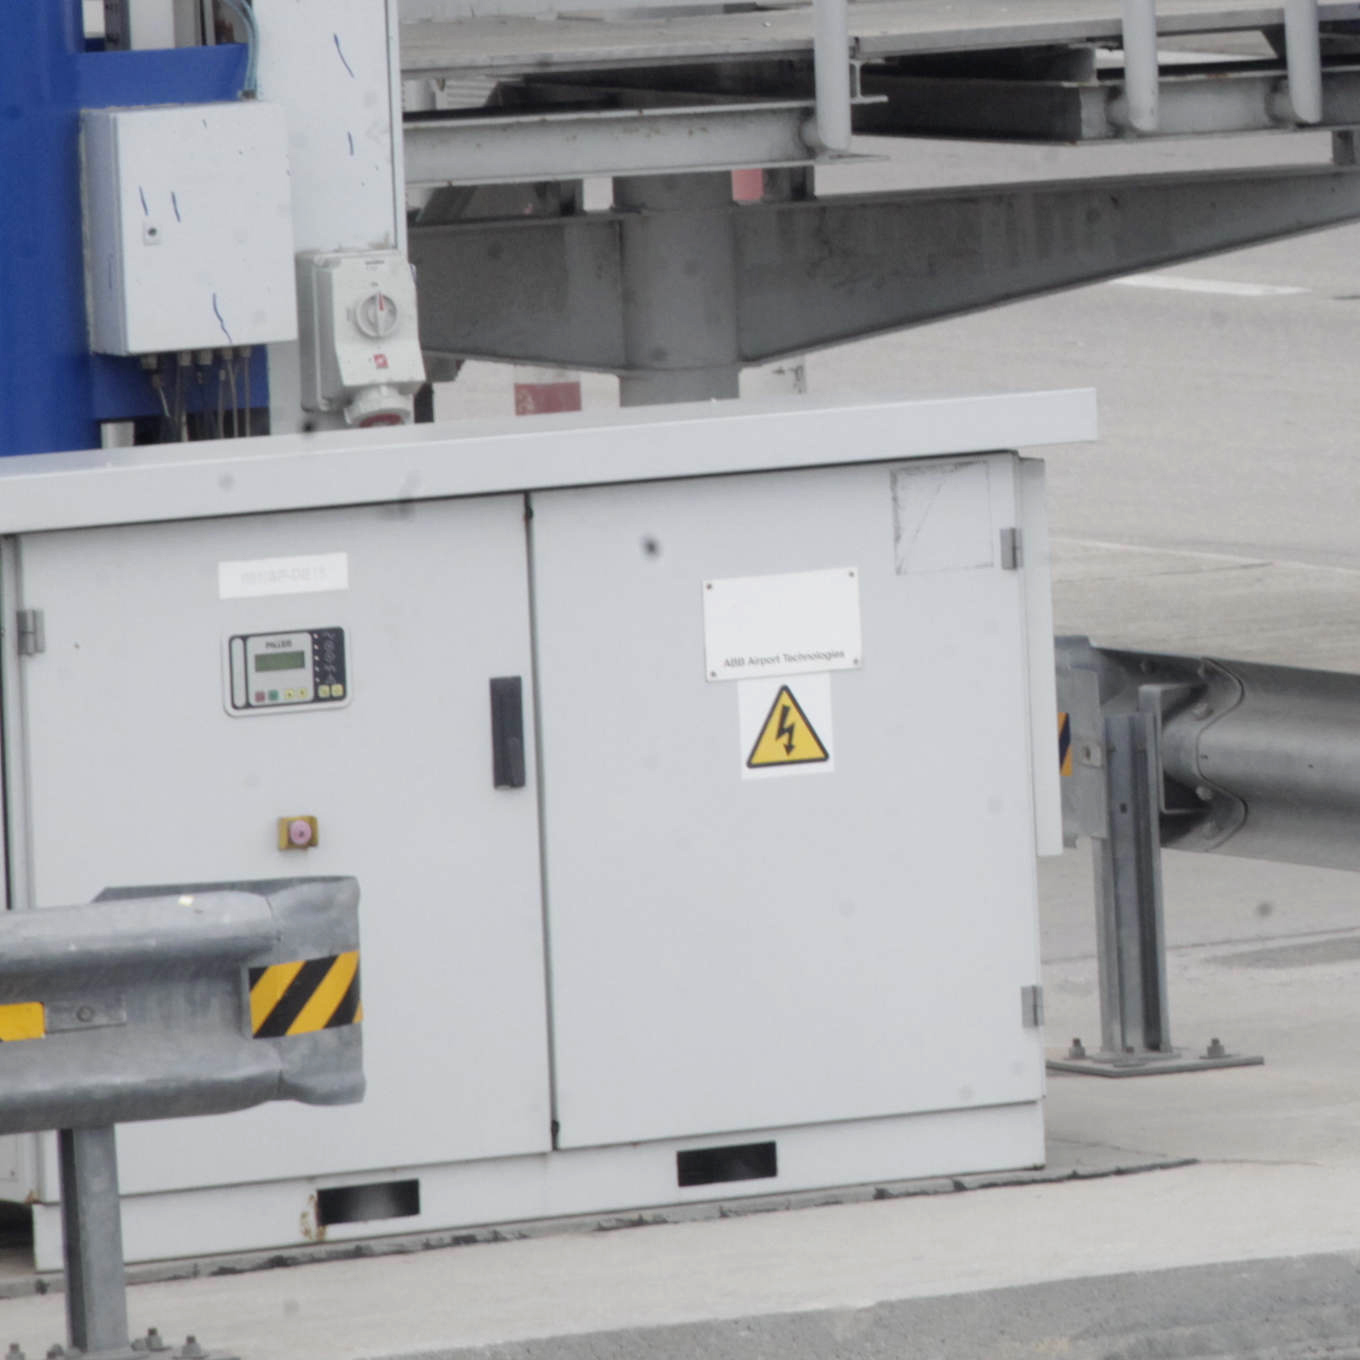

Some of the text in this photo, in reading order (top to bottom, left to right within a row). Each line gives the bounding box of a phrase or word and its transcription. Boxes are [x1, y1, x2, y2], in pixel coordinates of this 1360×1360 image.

[724, 651, 845, 667] ABB Airport Technologies
